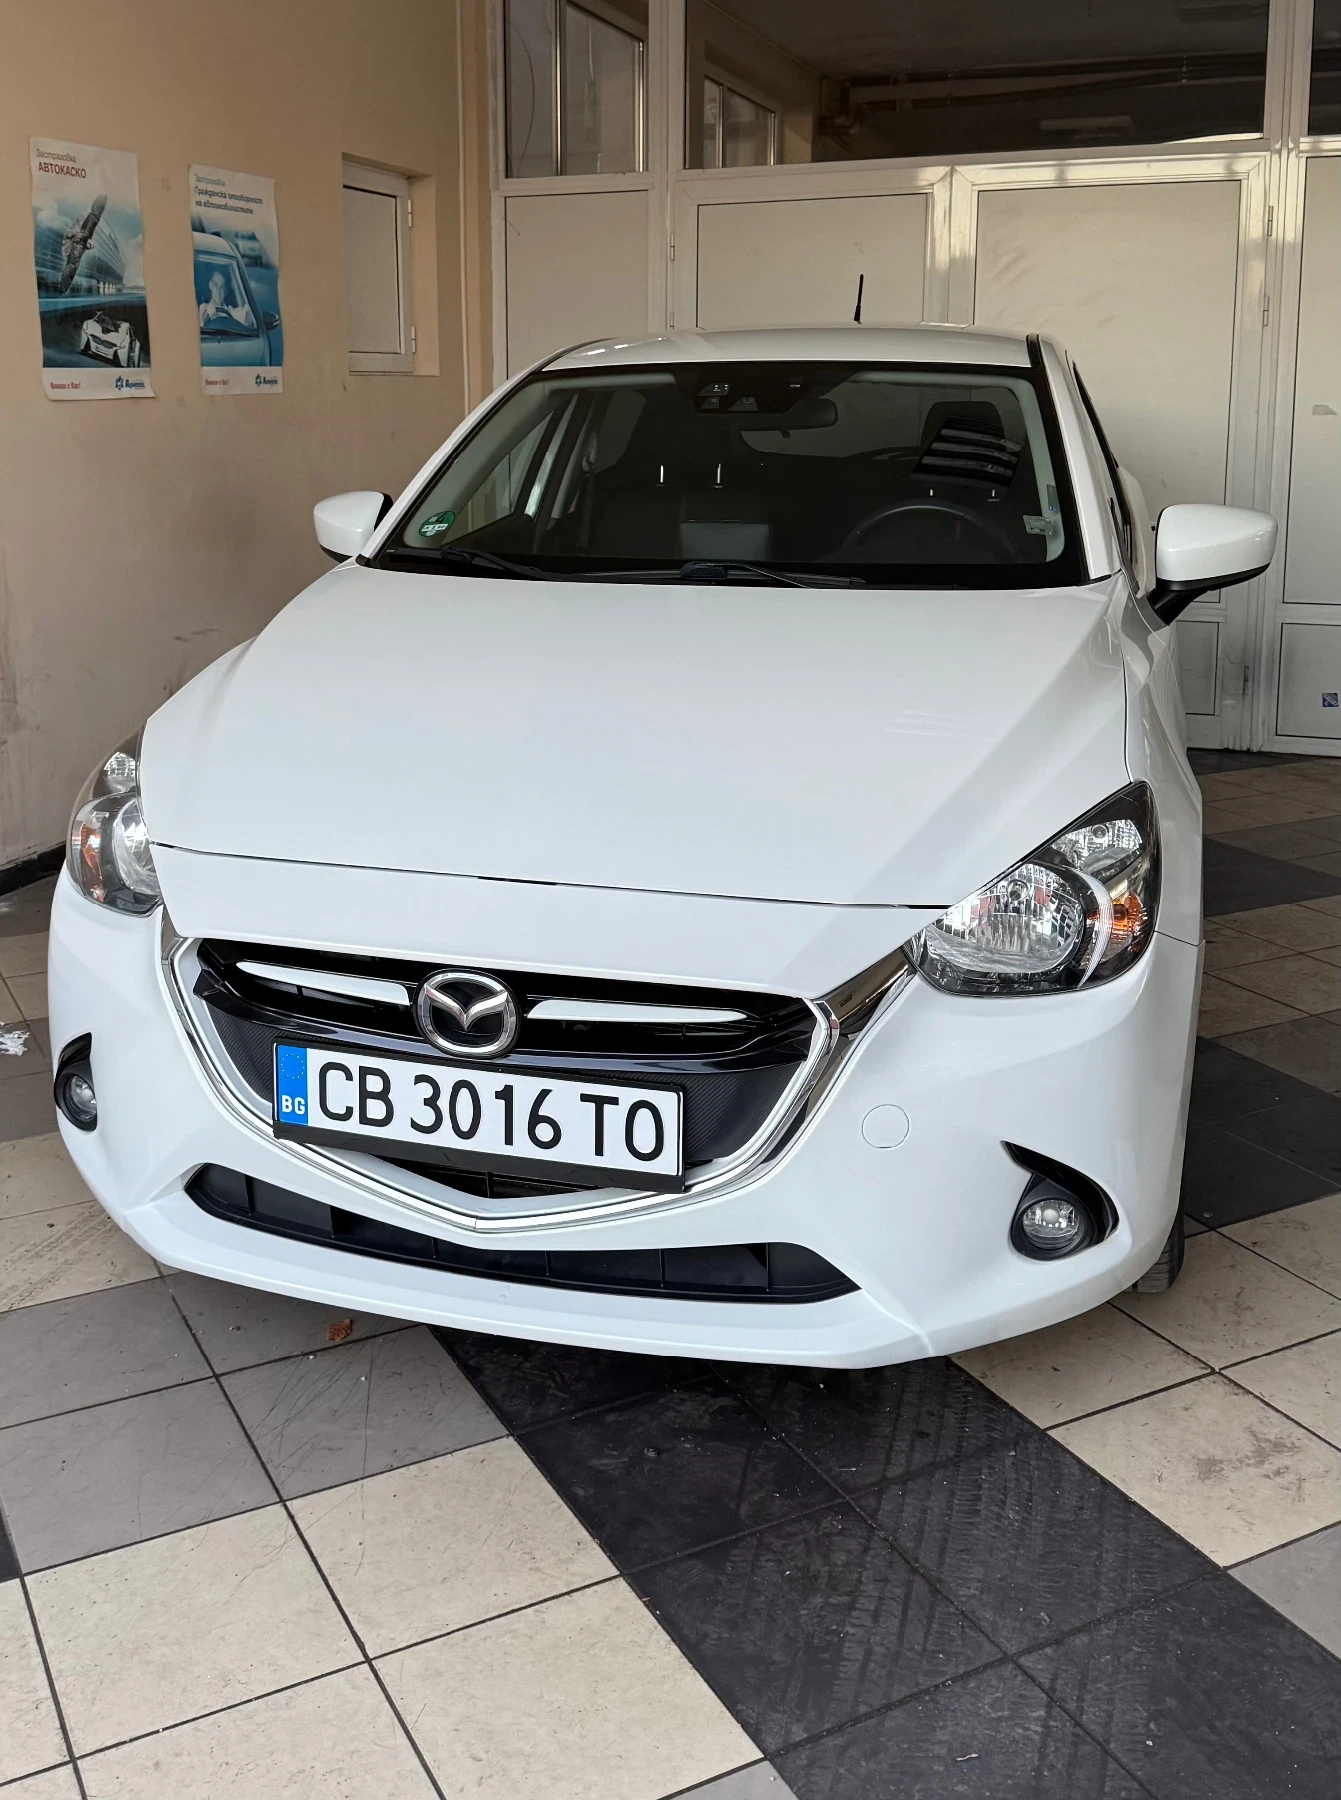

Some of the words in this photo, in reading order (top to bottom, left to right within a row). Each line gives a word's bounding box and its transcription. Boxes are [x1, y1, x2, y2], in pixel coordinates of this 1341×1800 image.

[38, 161, 87, 179] АВТОКАСКО
[281, 1094, 306, 1115] BG
[318, 1062, 395, 1128] CB
[409, 1074, 563, 1150] 3016
[579, 1093, 665, 1162] TO
